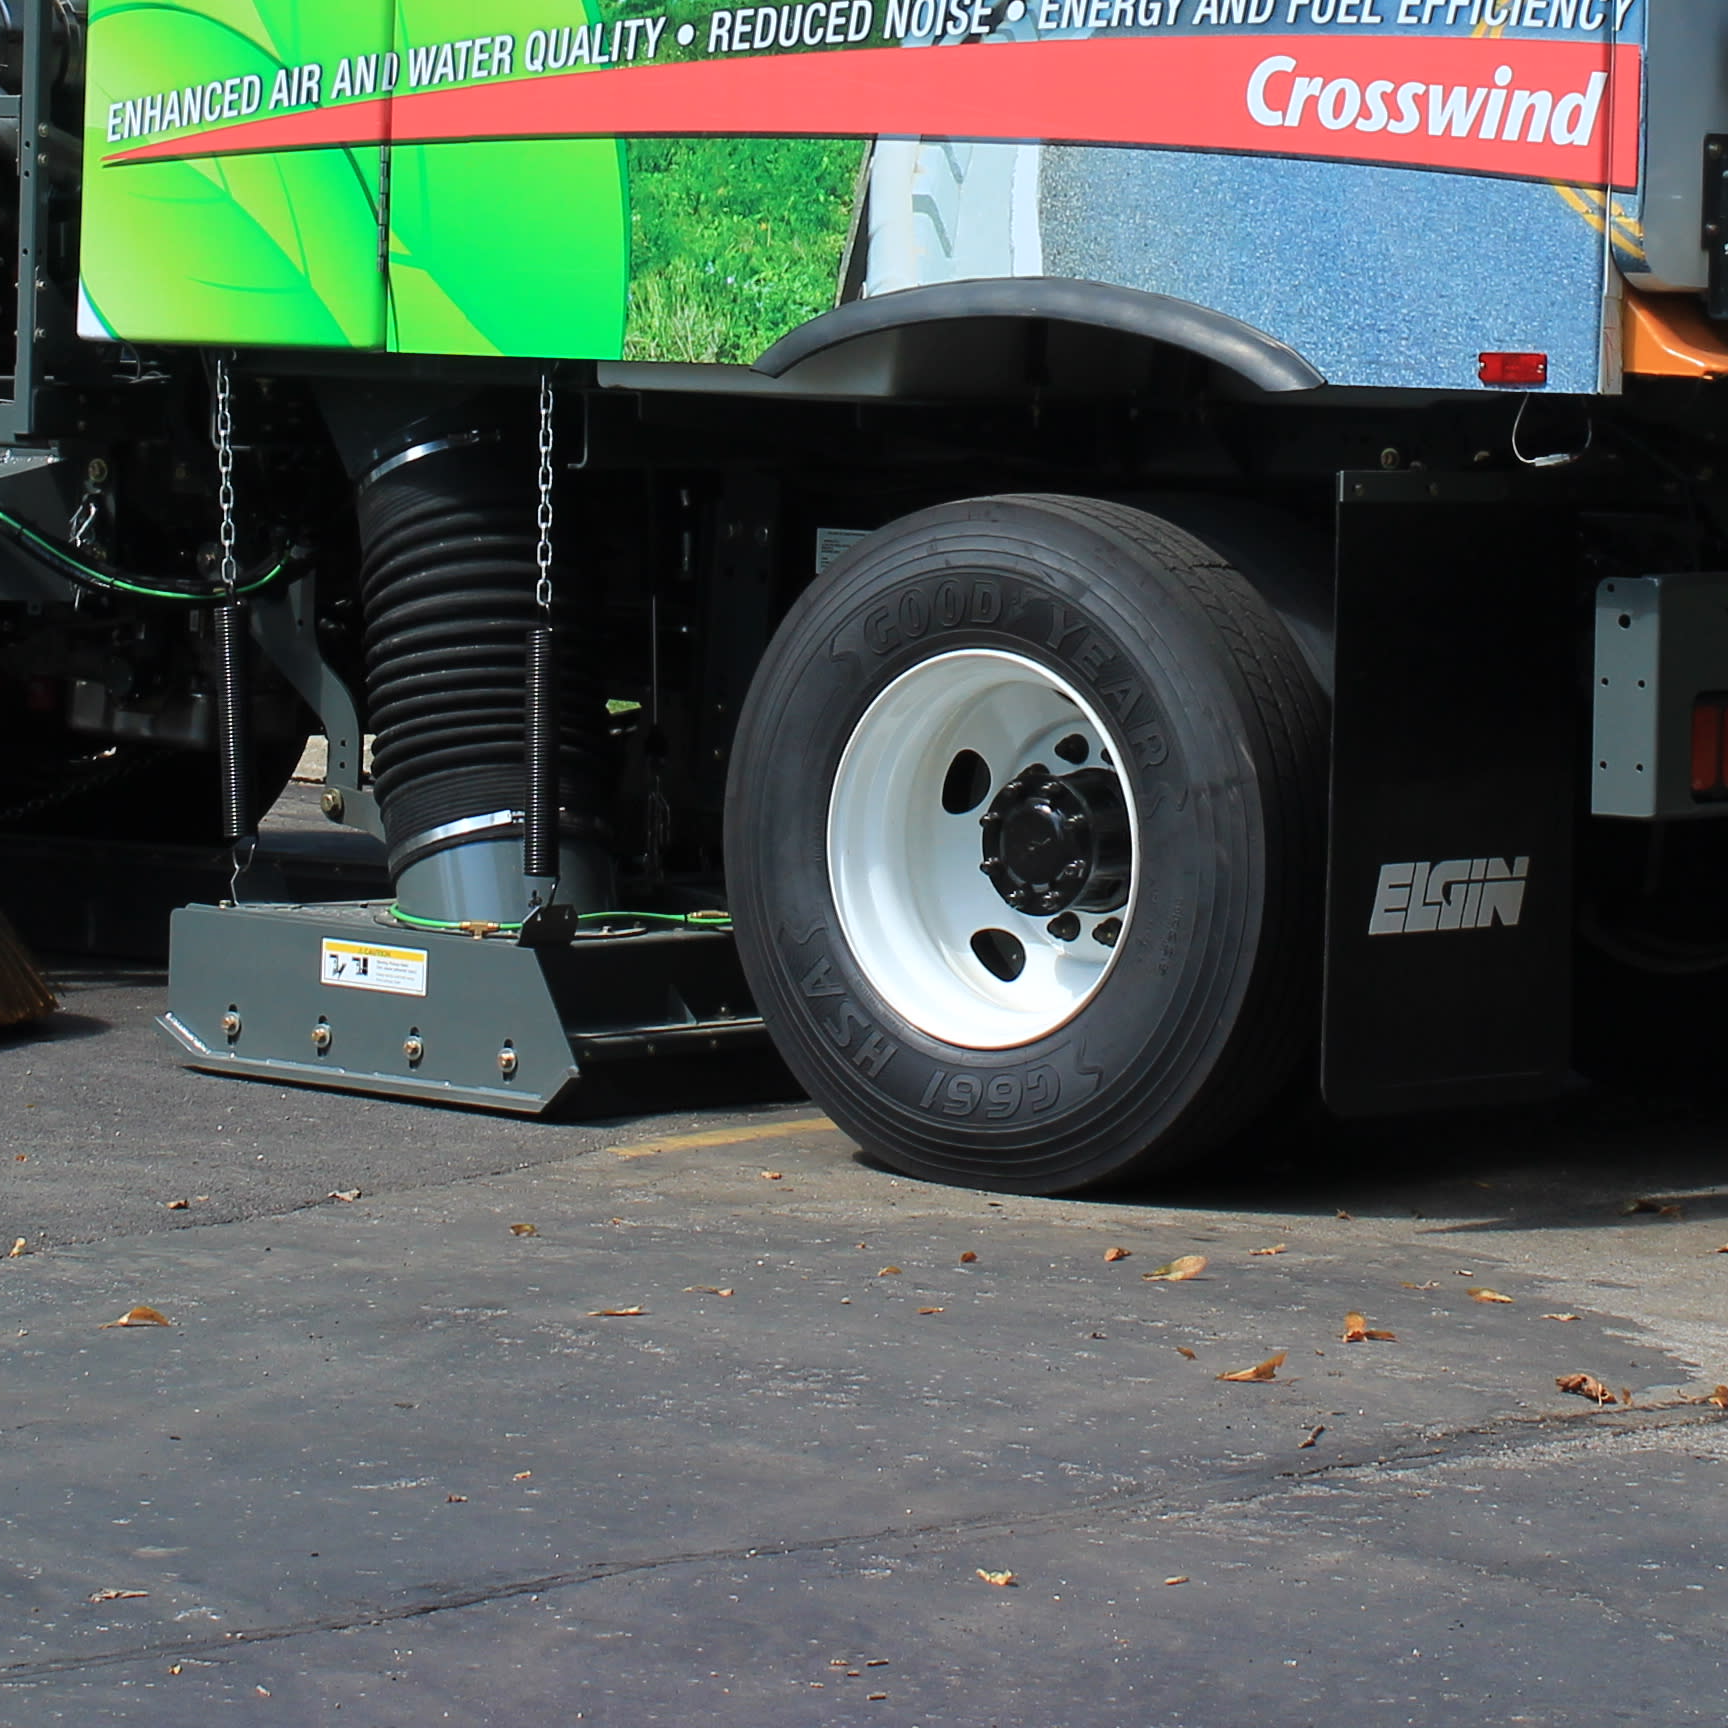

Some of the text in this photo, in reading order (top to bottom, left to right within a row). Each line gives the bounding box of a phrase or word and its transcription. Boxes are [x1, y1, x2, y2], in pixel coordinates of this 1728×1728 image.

[107, 74, 261, 142] ENHANCED
[269, 63, 322, 108] AIR
[331, 51, 400, 100] AND
[408, 34, 515, 88] WATER
[524, 16, 667, 72] QUALITY
[707, 0, 873, 53] REDUCED
[1246, 55, 1608, 147] Crosswind
[1368, 856, 1529, 935] ELGIN
[800, 955, 1061, 1120] G661 HSA
